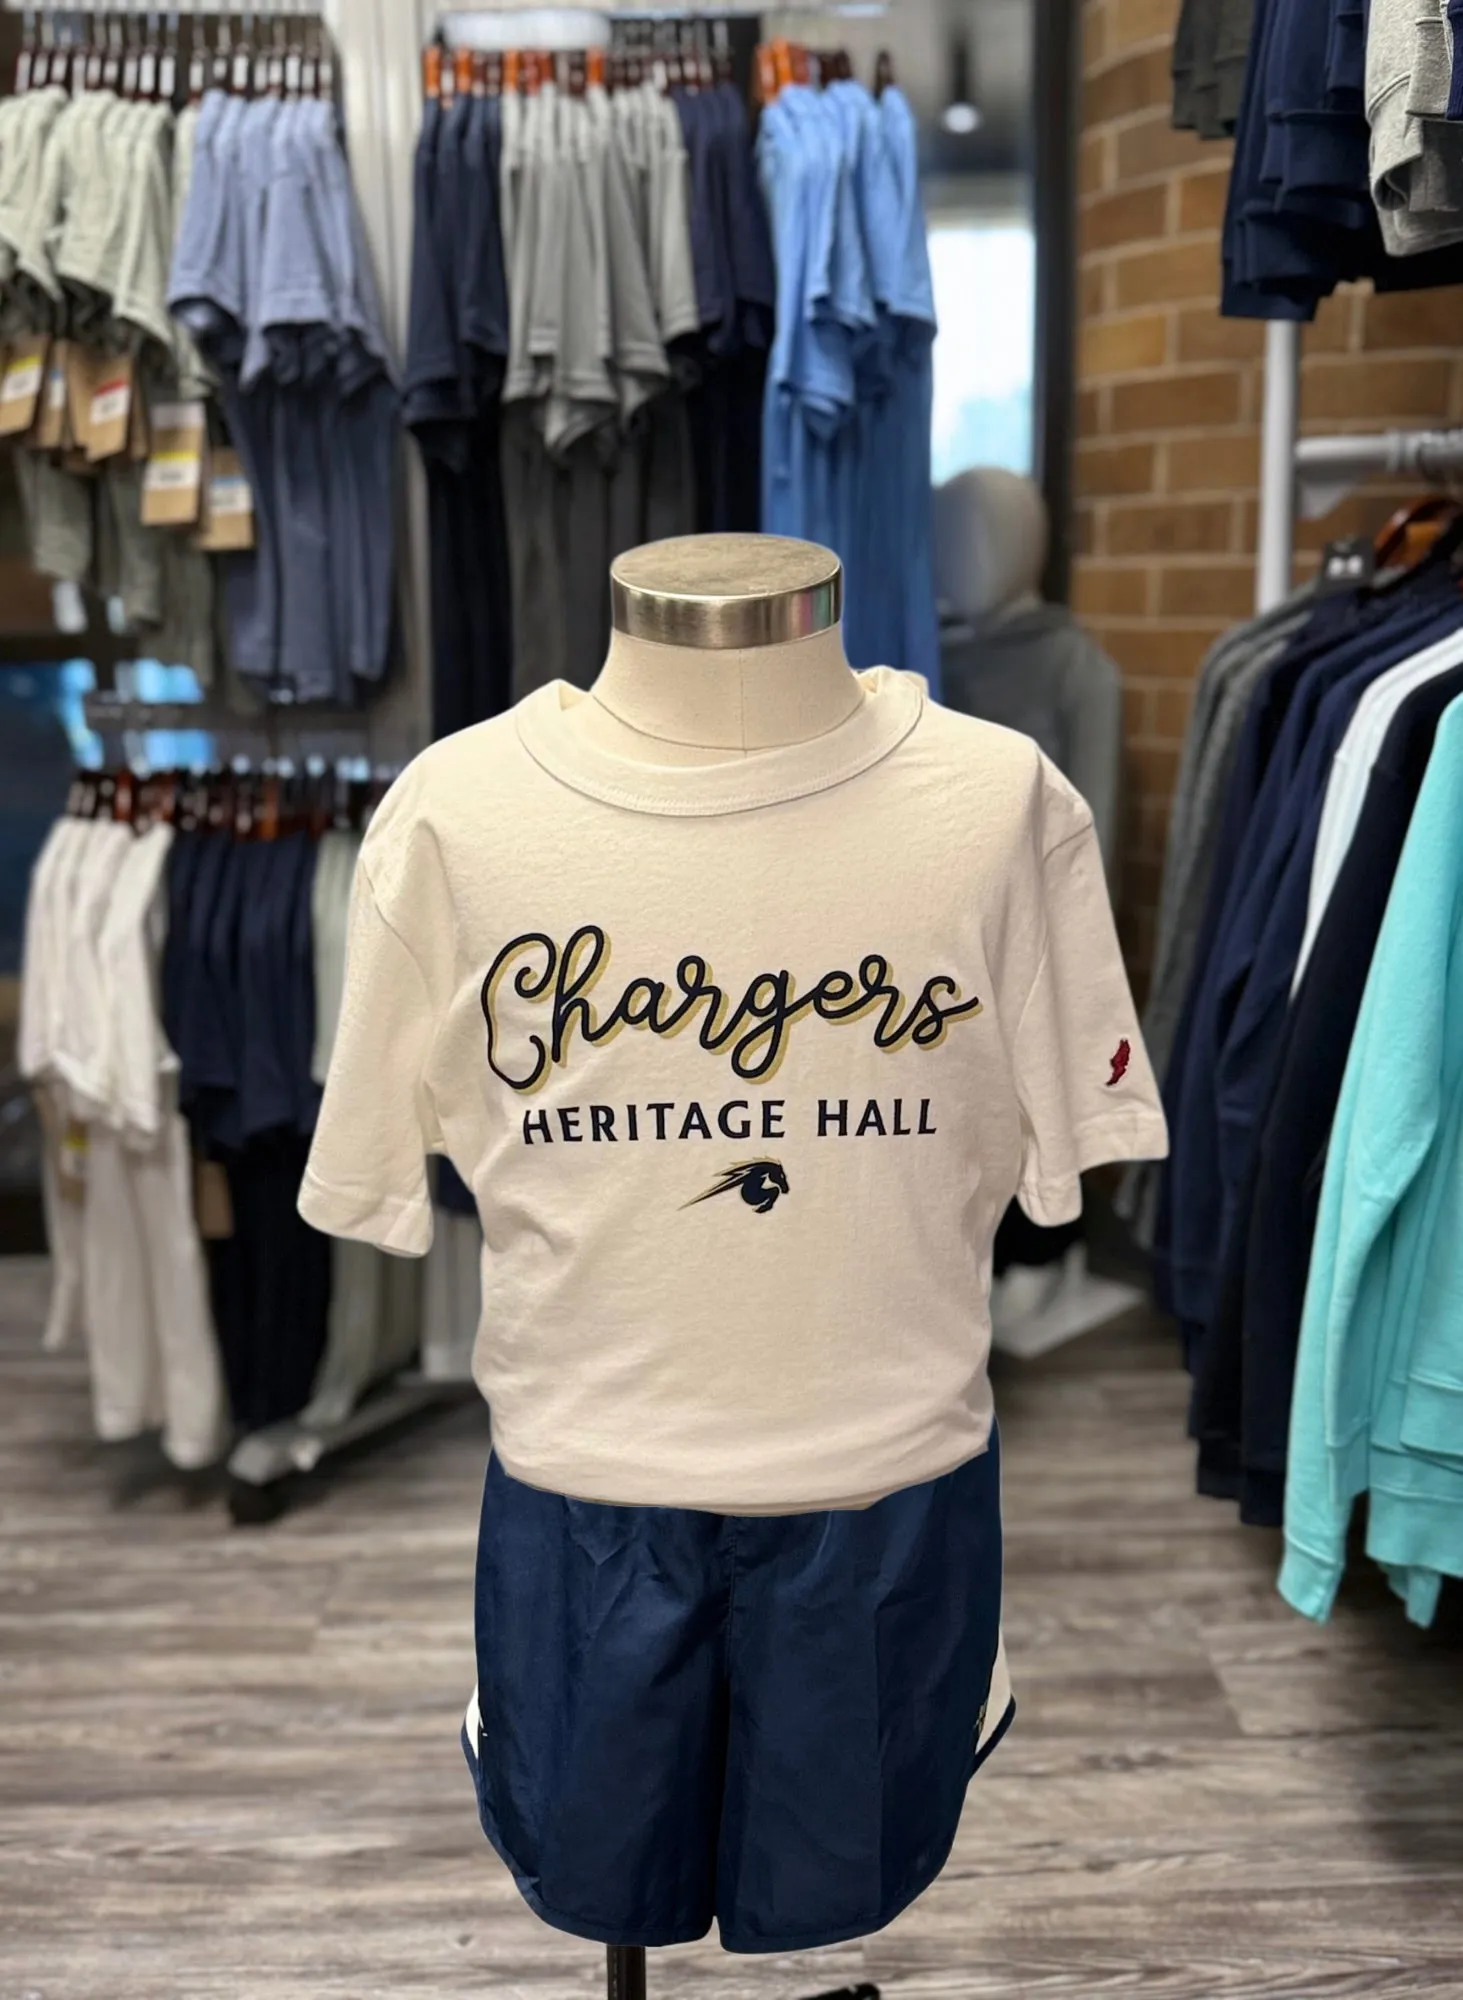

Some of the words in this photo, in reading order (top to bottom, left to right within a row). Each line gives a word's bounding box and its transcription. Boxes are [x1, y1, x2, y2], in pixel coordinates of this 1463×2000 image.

[481, 925, 982, 1093] Chargers
[523, 1099, 786, 1145] HERITAGE
[816, 1098, 937, 1137] HALL
